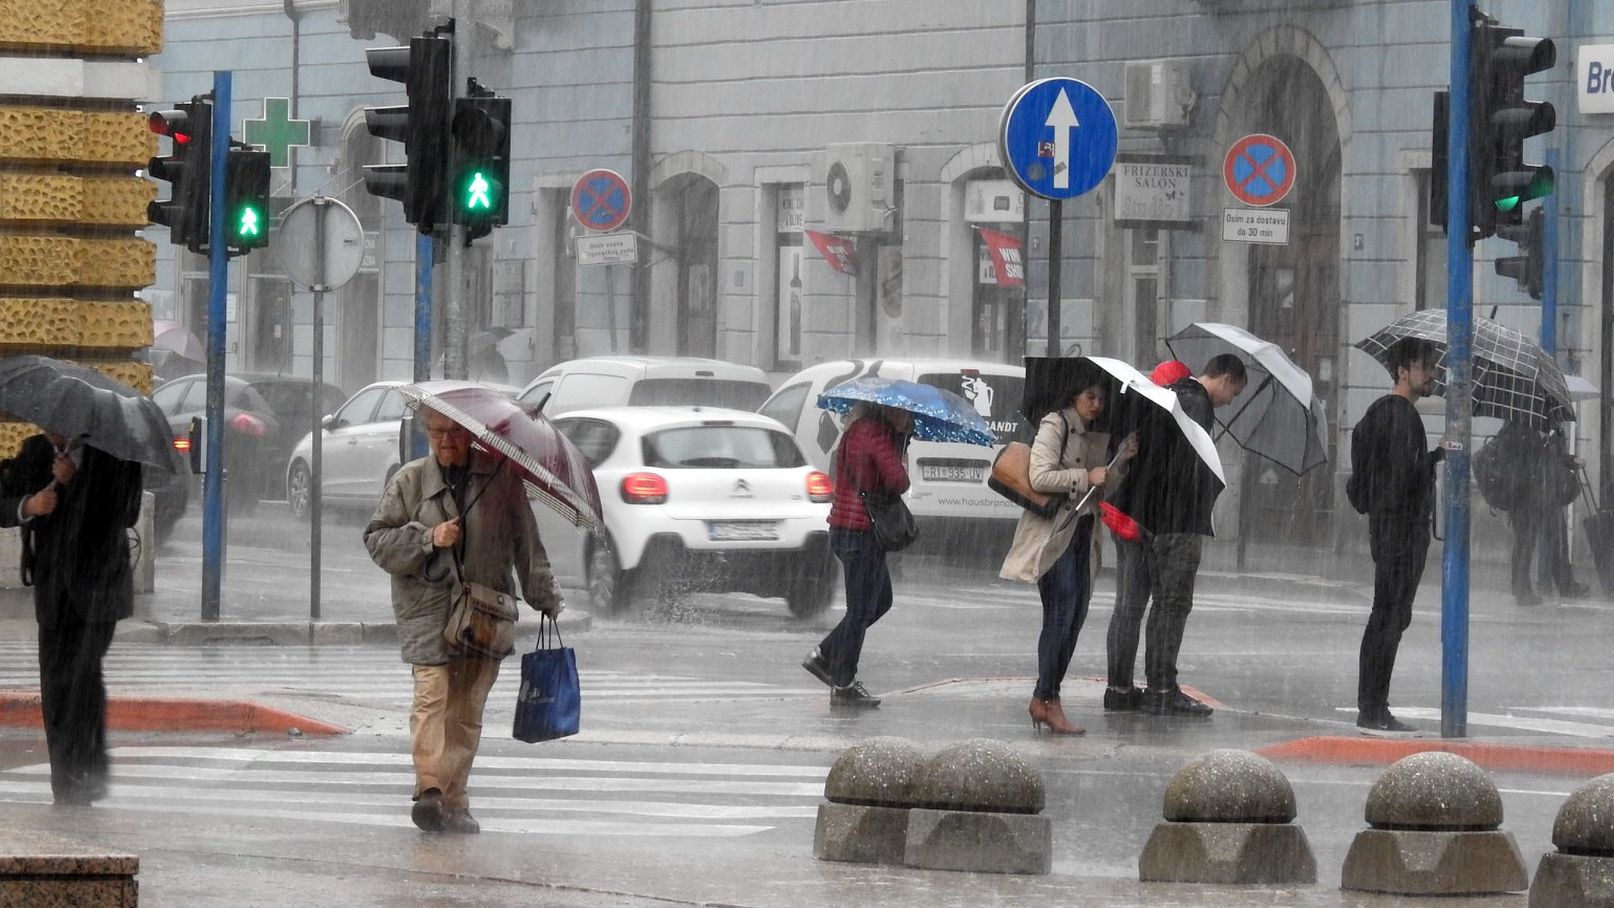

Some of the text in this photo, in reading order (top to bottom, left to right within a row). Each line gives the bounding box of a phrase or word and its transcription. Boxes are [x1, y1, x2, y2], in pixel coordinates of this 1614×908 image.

[1123, 165, 1189, 178] FRIZERSKI
[1135, 176, 1177, 189] SALON
[1226, 213, 1286, 225] Osim za dostavu
[1237, 227, 1273, 238] do 30 min
[949, 467, 966, 479] 935
